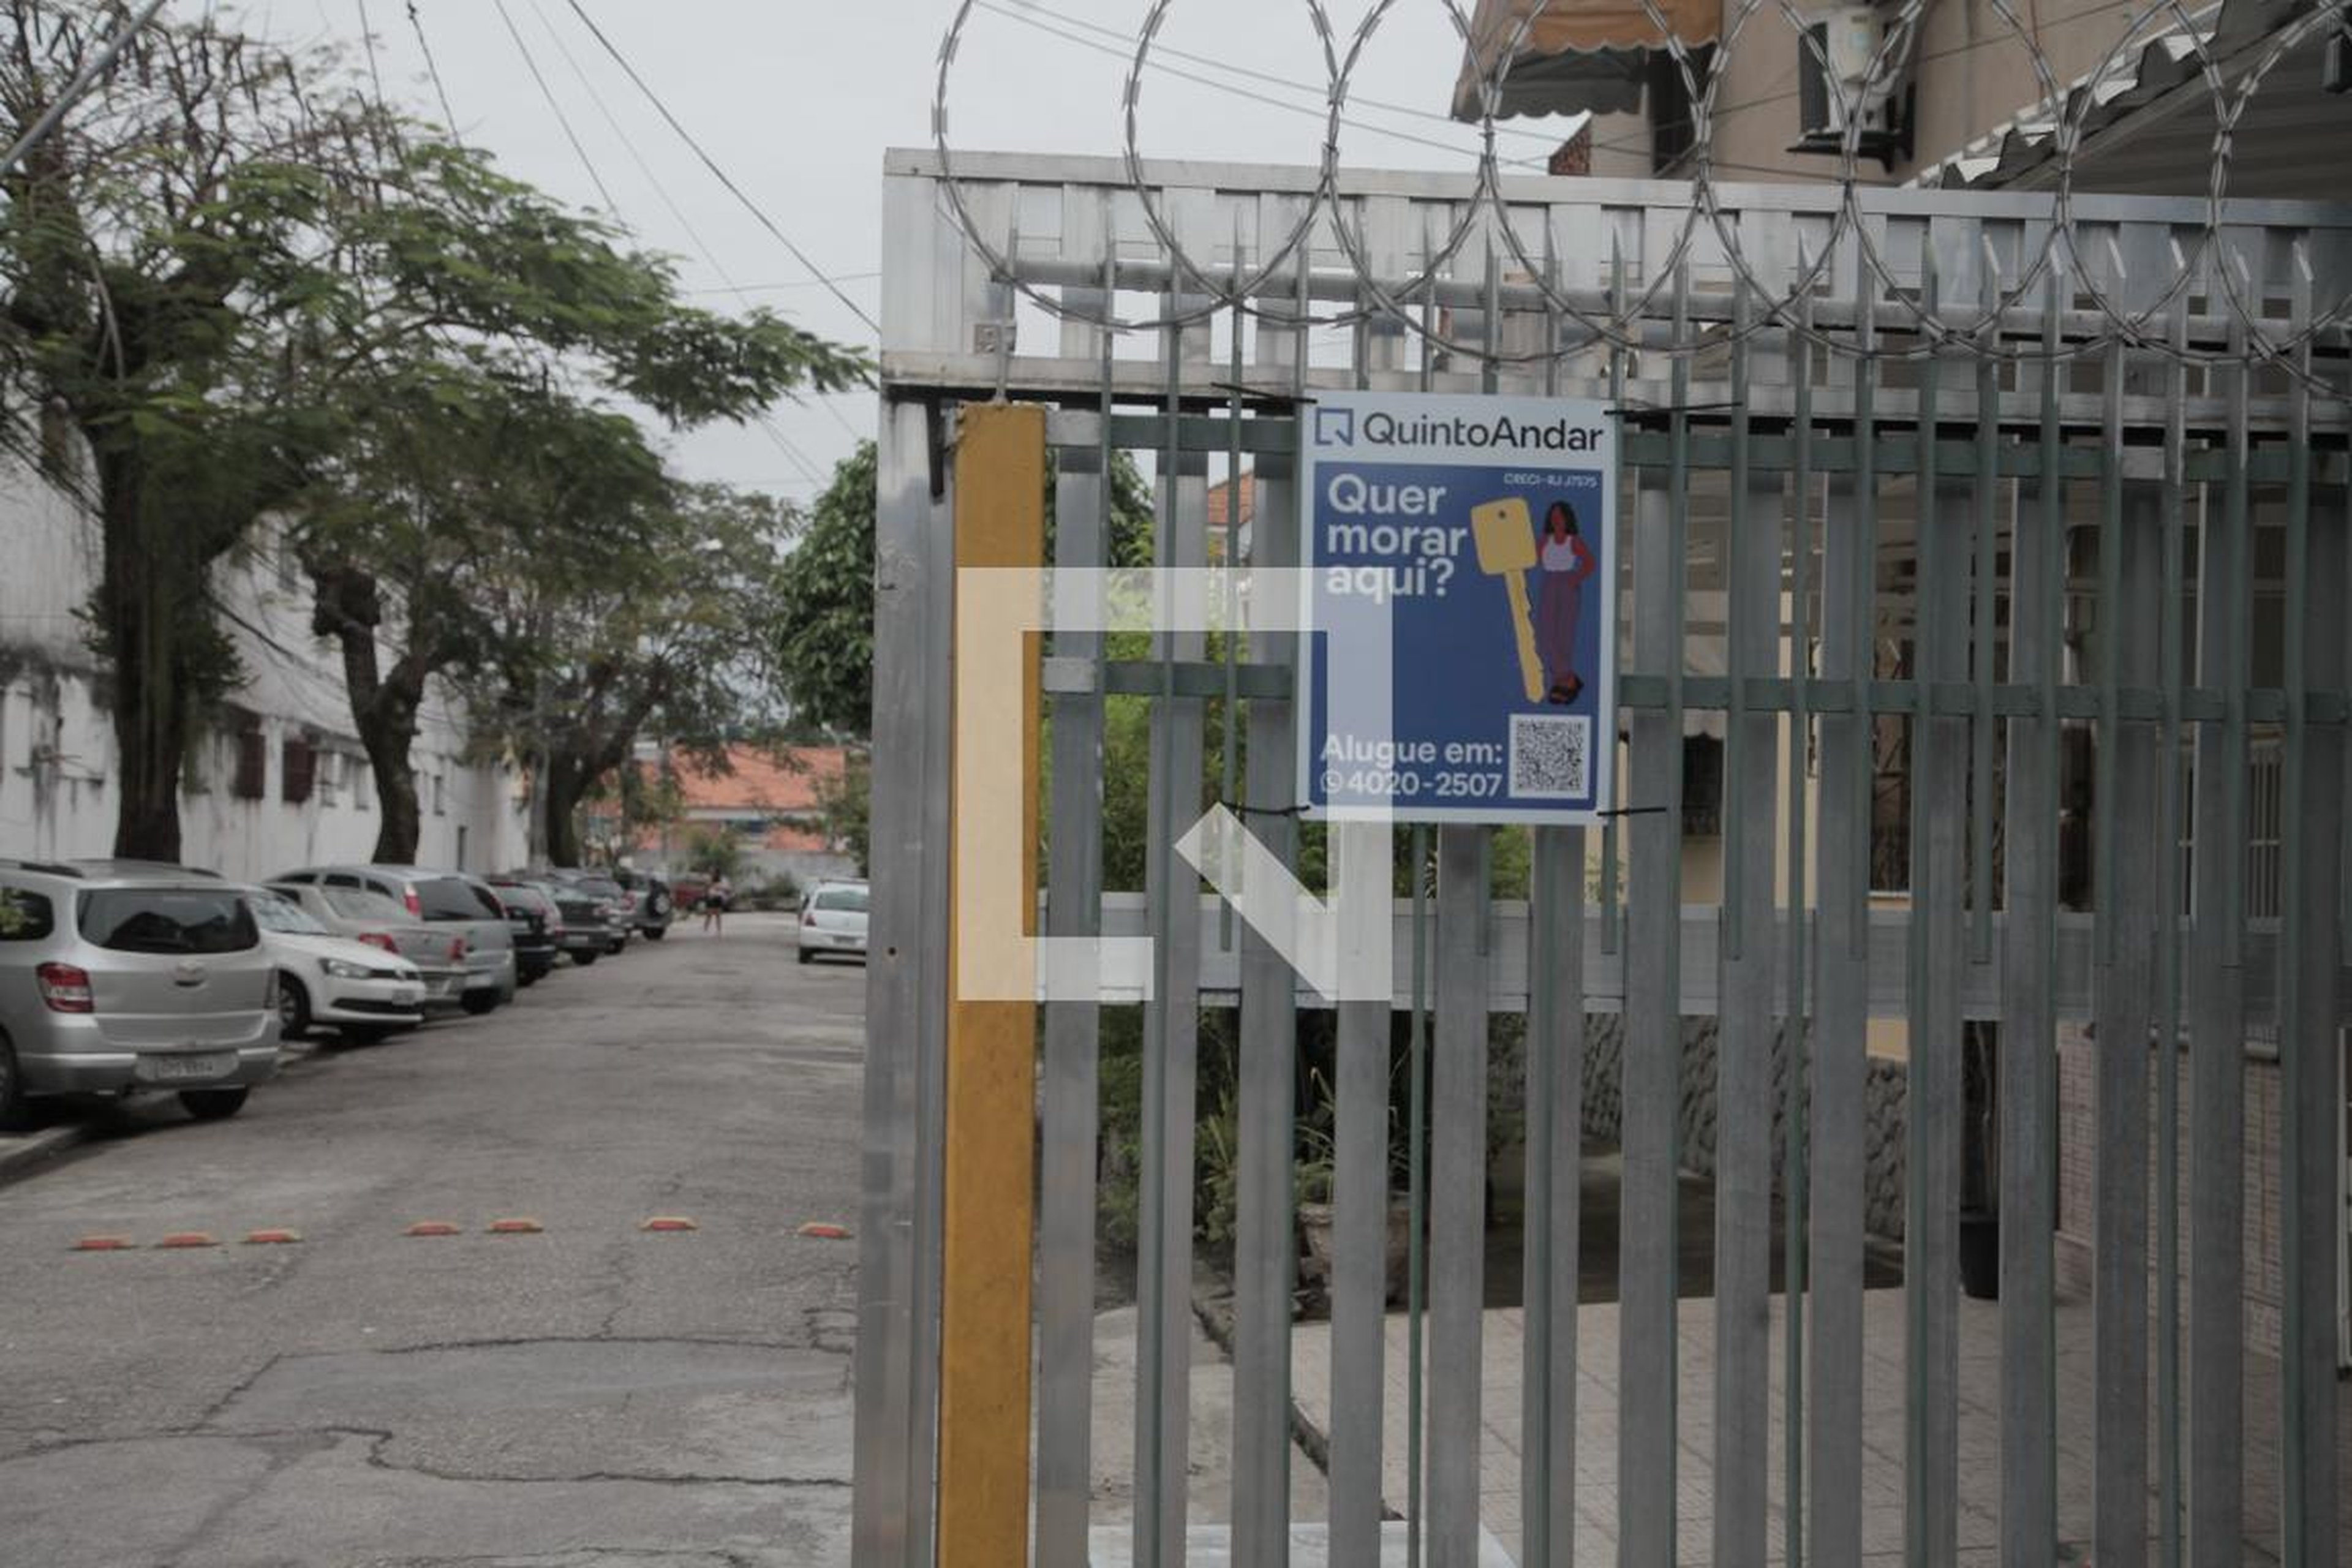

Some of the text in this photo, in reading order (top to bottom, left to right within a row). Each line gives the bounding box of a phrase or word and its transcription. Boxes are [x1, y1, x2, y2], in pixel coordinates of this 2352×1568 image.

[1363, 412, 1604, 451] QuintoAndar
[1328, 473, 1447, 514] Quer
[1328, 524, 1468, 556] morar
[1326, 557, 1455, 605] aqui?
[1320, 734, 1503, 769] Alugue em:
[1348, 770, 1503, 796] 4020-2507
